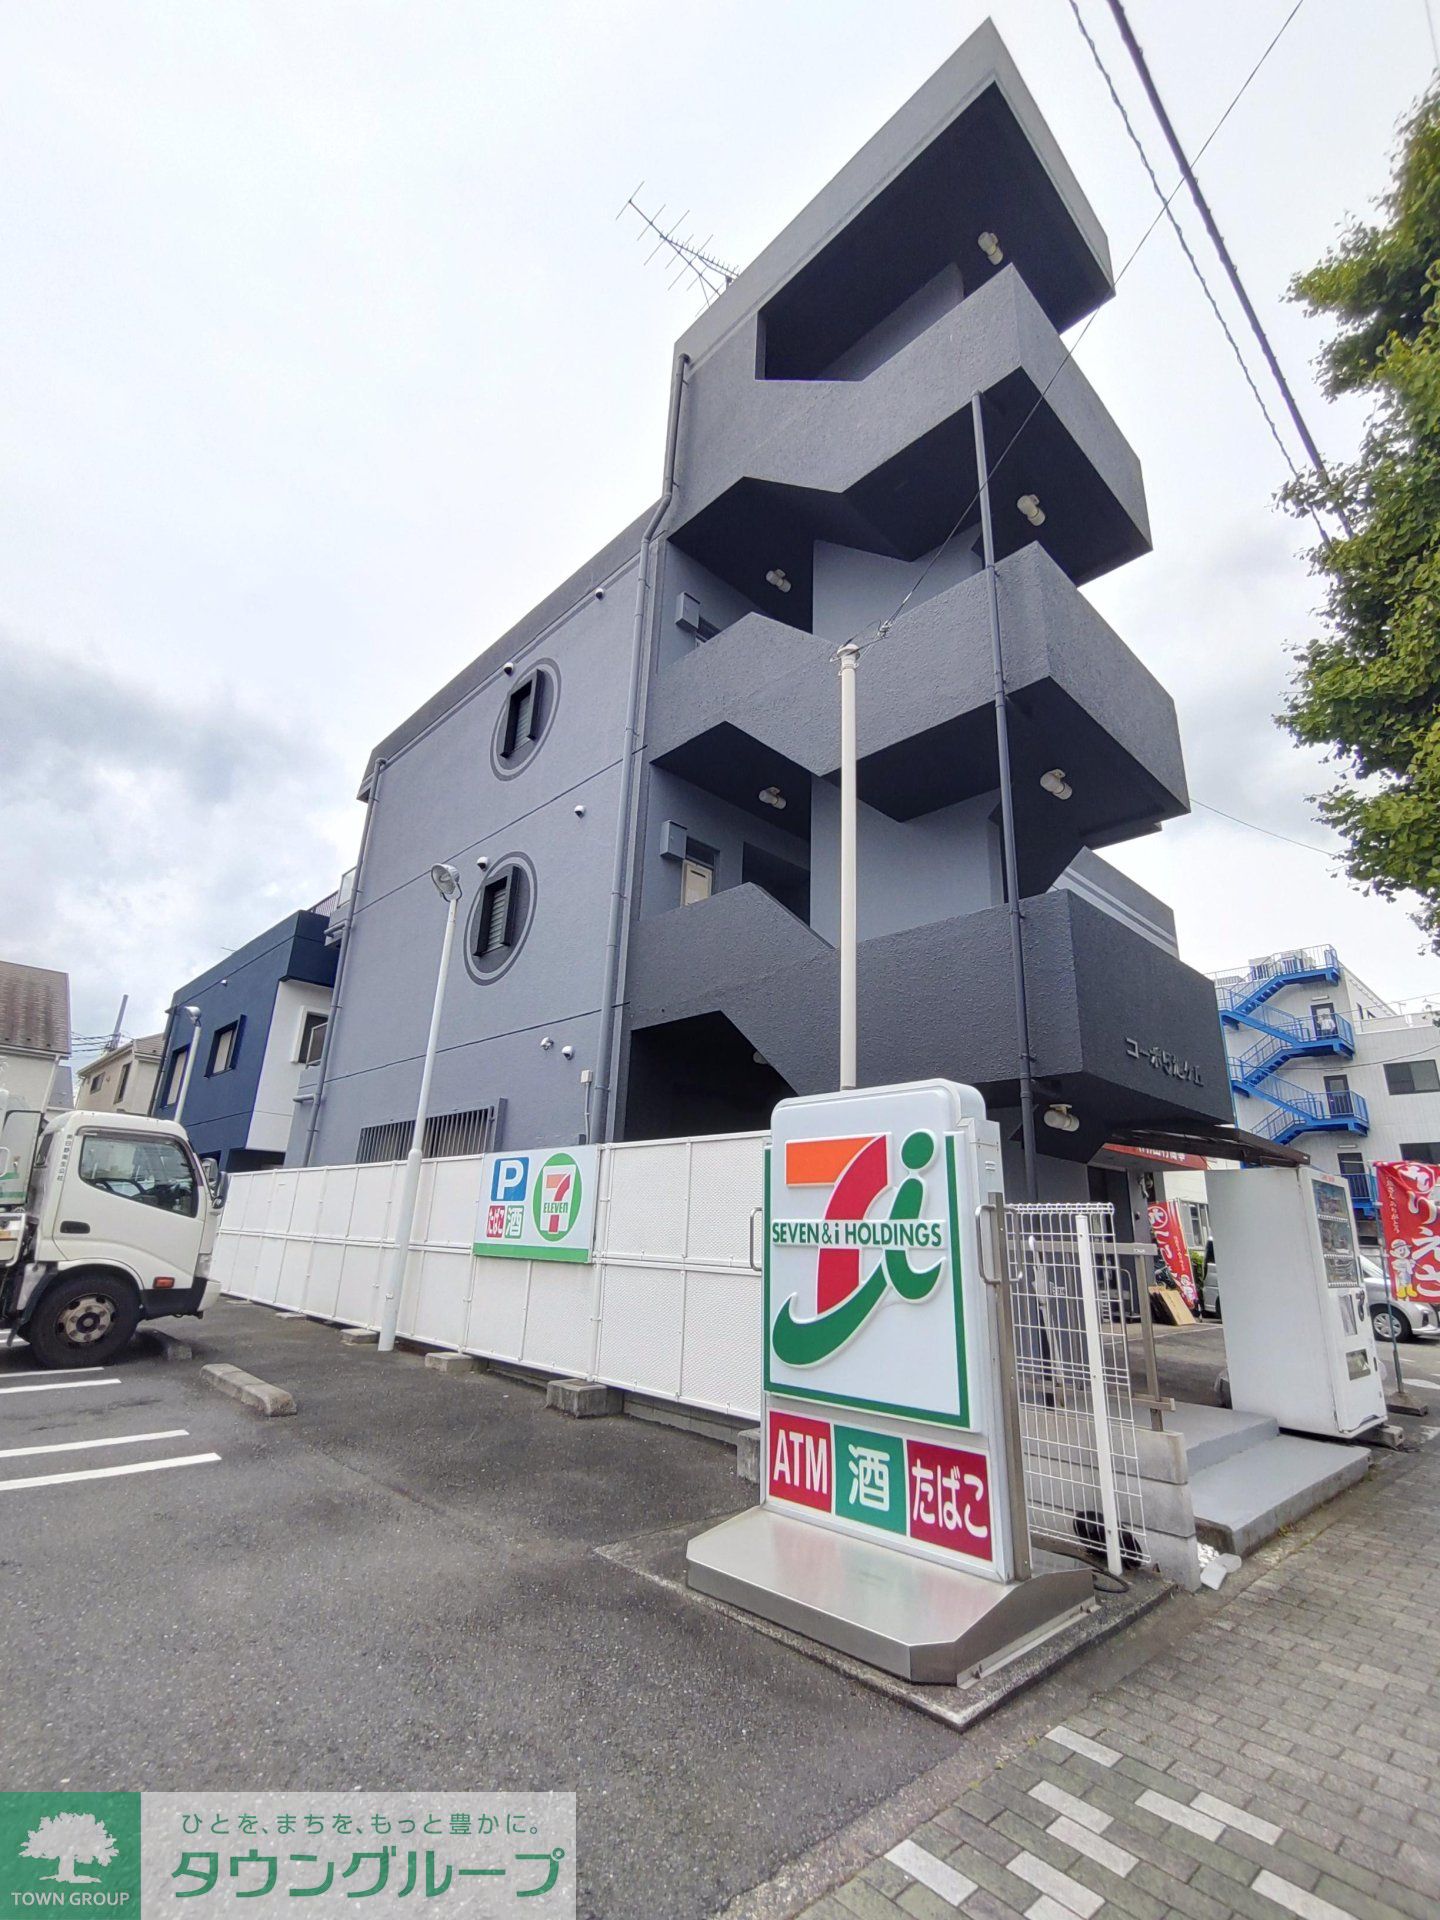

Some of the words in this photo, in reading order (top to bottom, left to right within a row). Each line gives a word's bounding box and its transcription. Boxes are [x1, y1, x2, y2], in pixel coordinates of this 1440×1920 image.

[497, 1160, 524, 1200] P
[845, 1222, 943, 1248] HOLDINGS
[773, 1430, 828, 1495] ATM
[848, 1444, 890, 1510] 酒
[912, 1458, 988, 1538] たばこ
